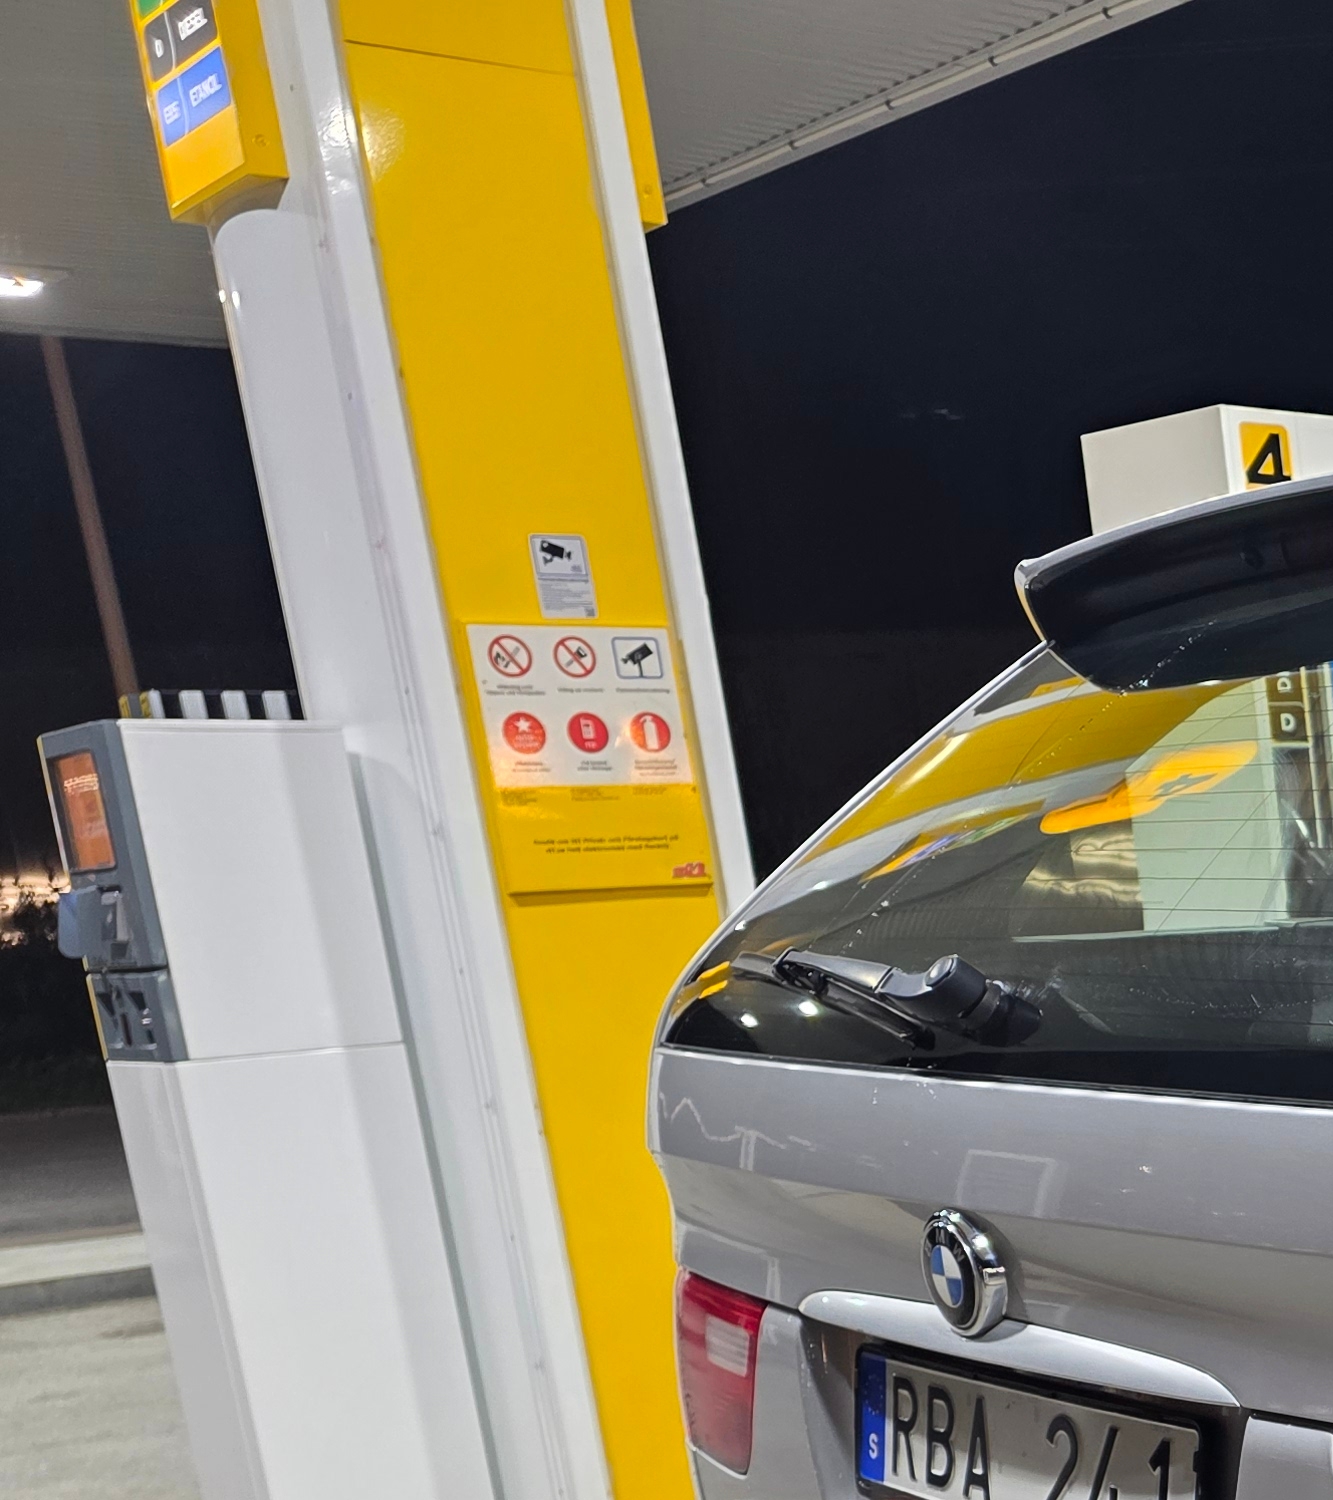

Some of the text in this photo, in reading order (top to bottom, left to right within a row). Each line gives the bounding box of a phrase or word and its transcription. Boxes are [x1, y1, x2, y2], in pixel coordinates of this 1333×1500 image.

[1246, 432, 1291, 484] 4
[1280, 712, 1295, 733] D
[868, 1432, 880, 1460] S
